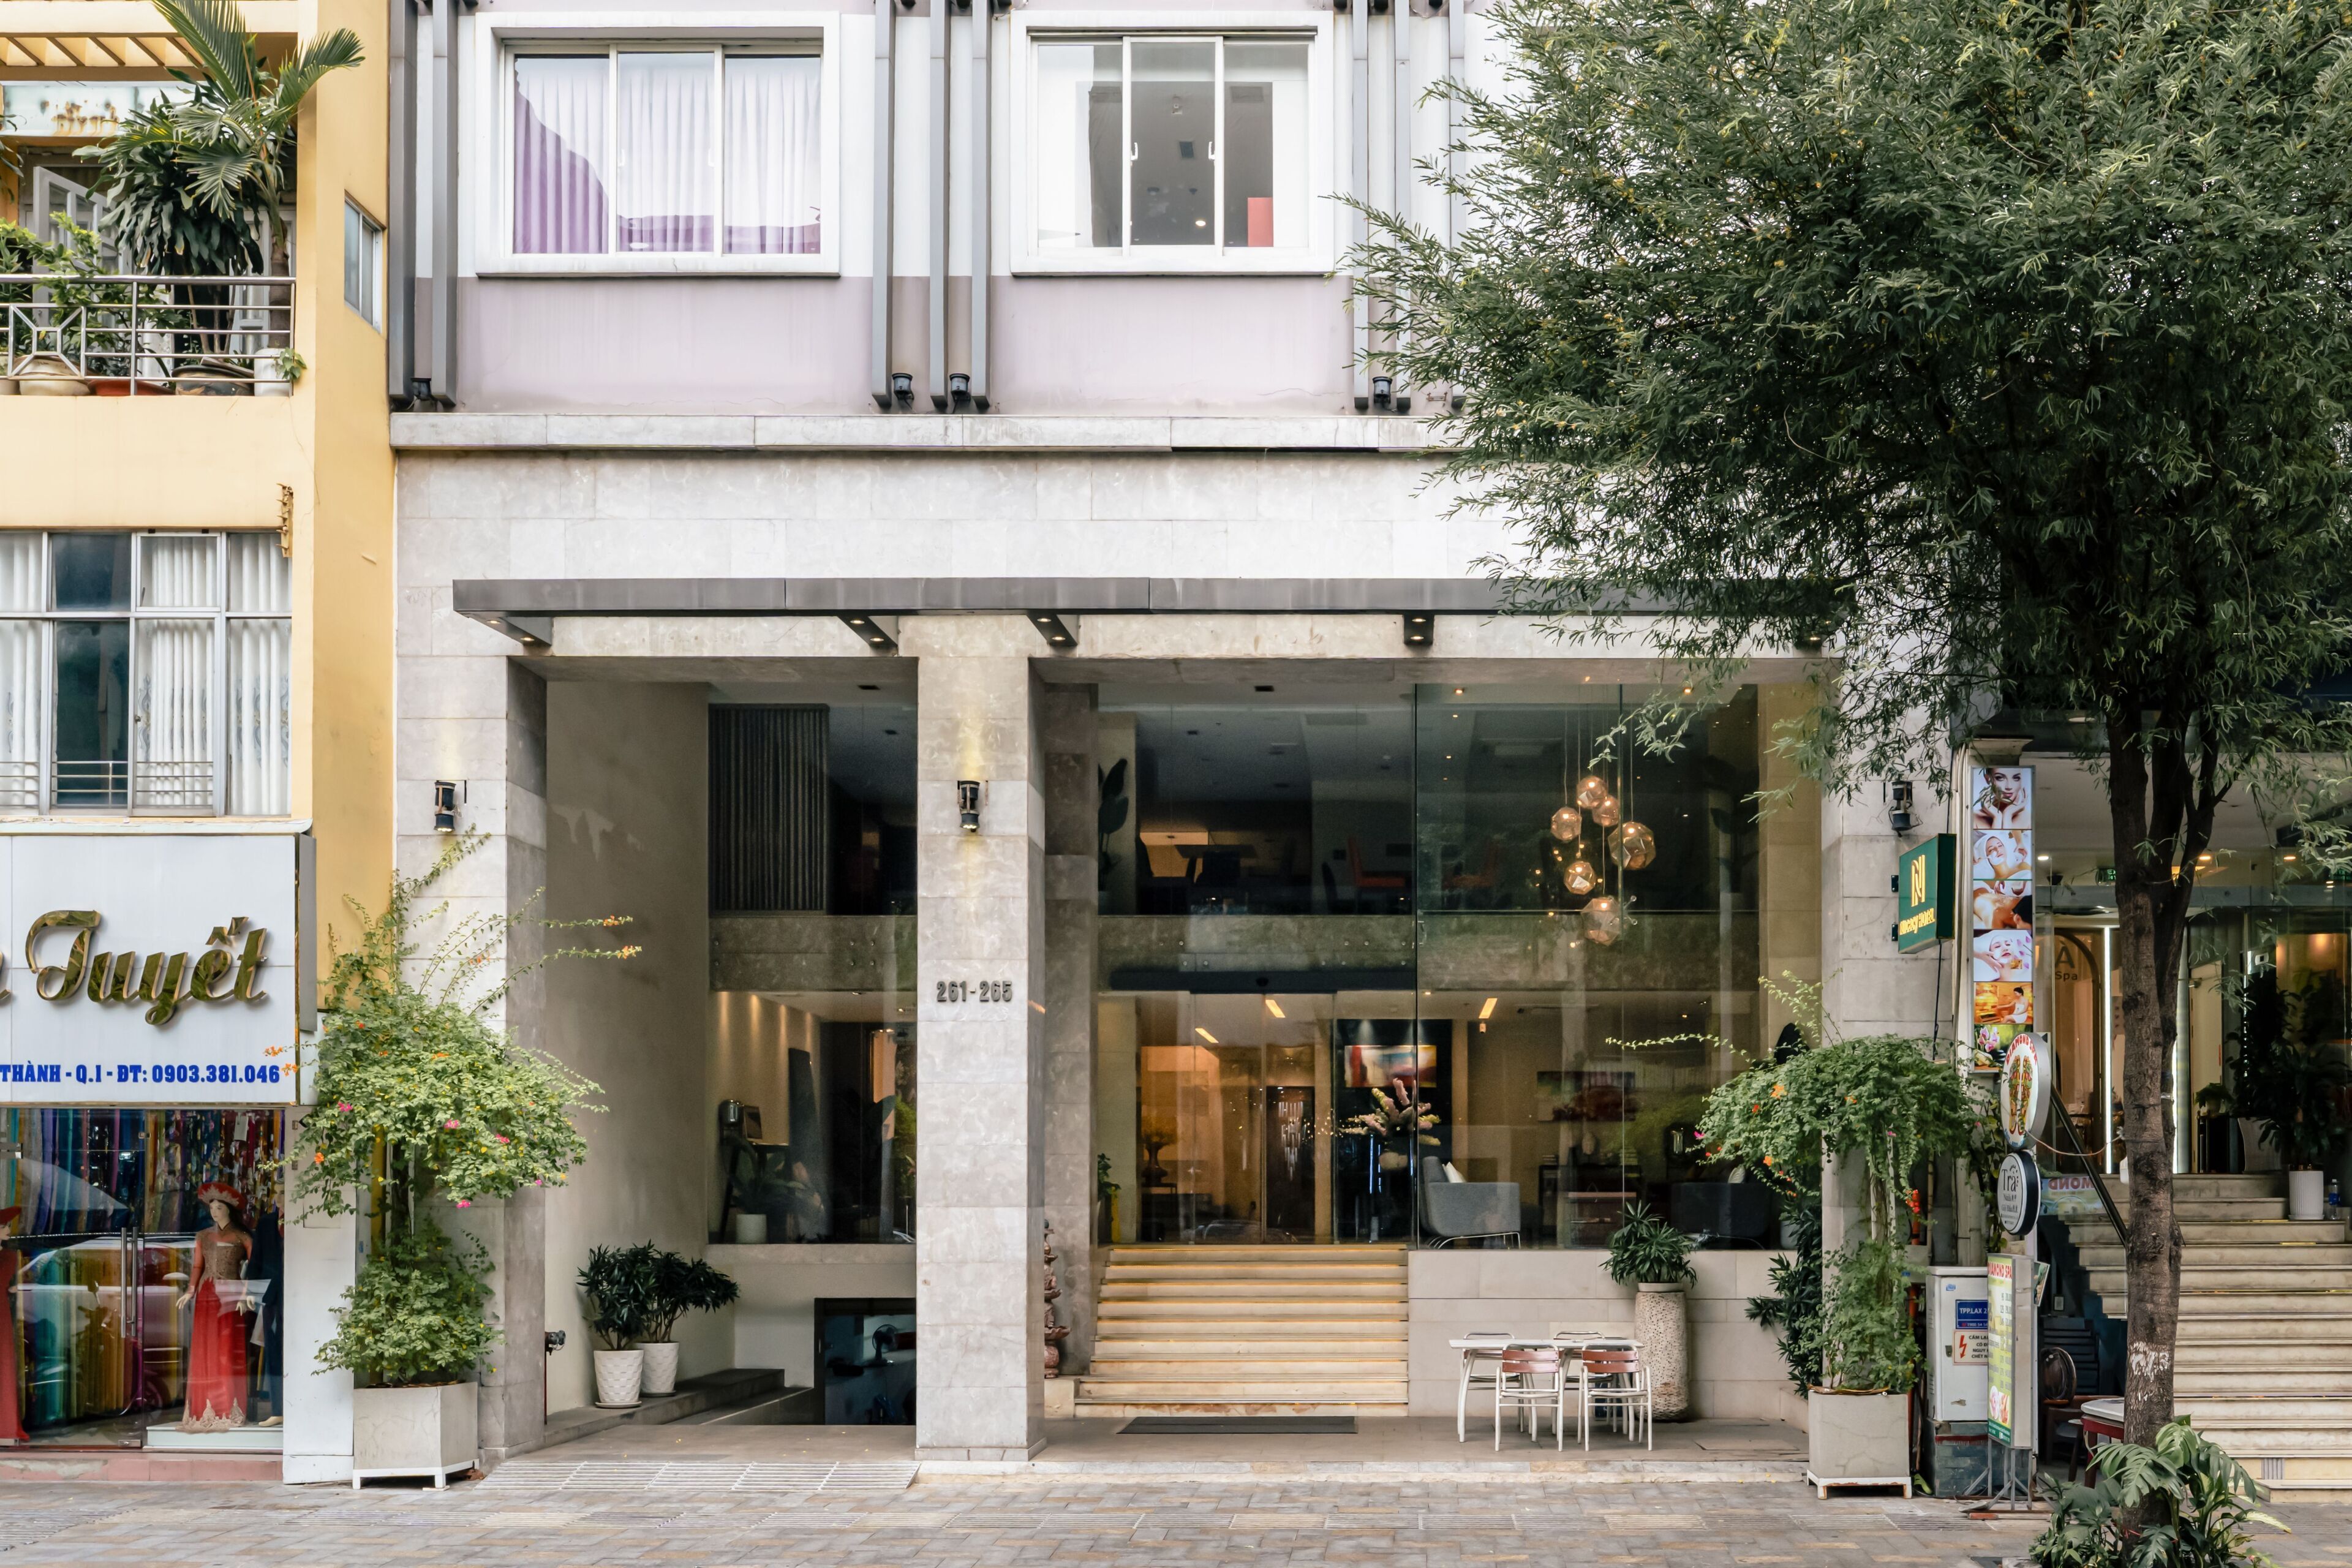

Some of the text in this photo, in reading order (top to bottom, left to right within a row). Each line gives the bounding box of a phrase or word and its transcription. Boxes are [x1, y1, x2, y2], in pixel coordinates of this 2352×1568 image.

[25, 910, 268, 1025] Tuyết
[2055, 971, 2078, 982] Spa
[2006, 1035, 2029, 1066] DIAMOND
[0, 1060, 61, 1082] THÀNH
[117, 1065, 147, 1083] ĐT:
[152, 1065, 279, 1083] 0903.381.046
[1988, 1262, 2004, 1278] DIAMOND
